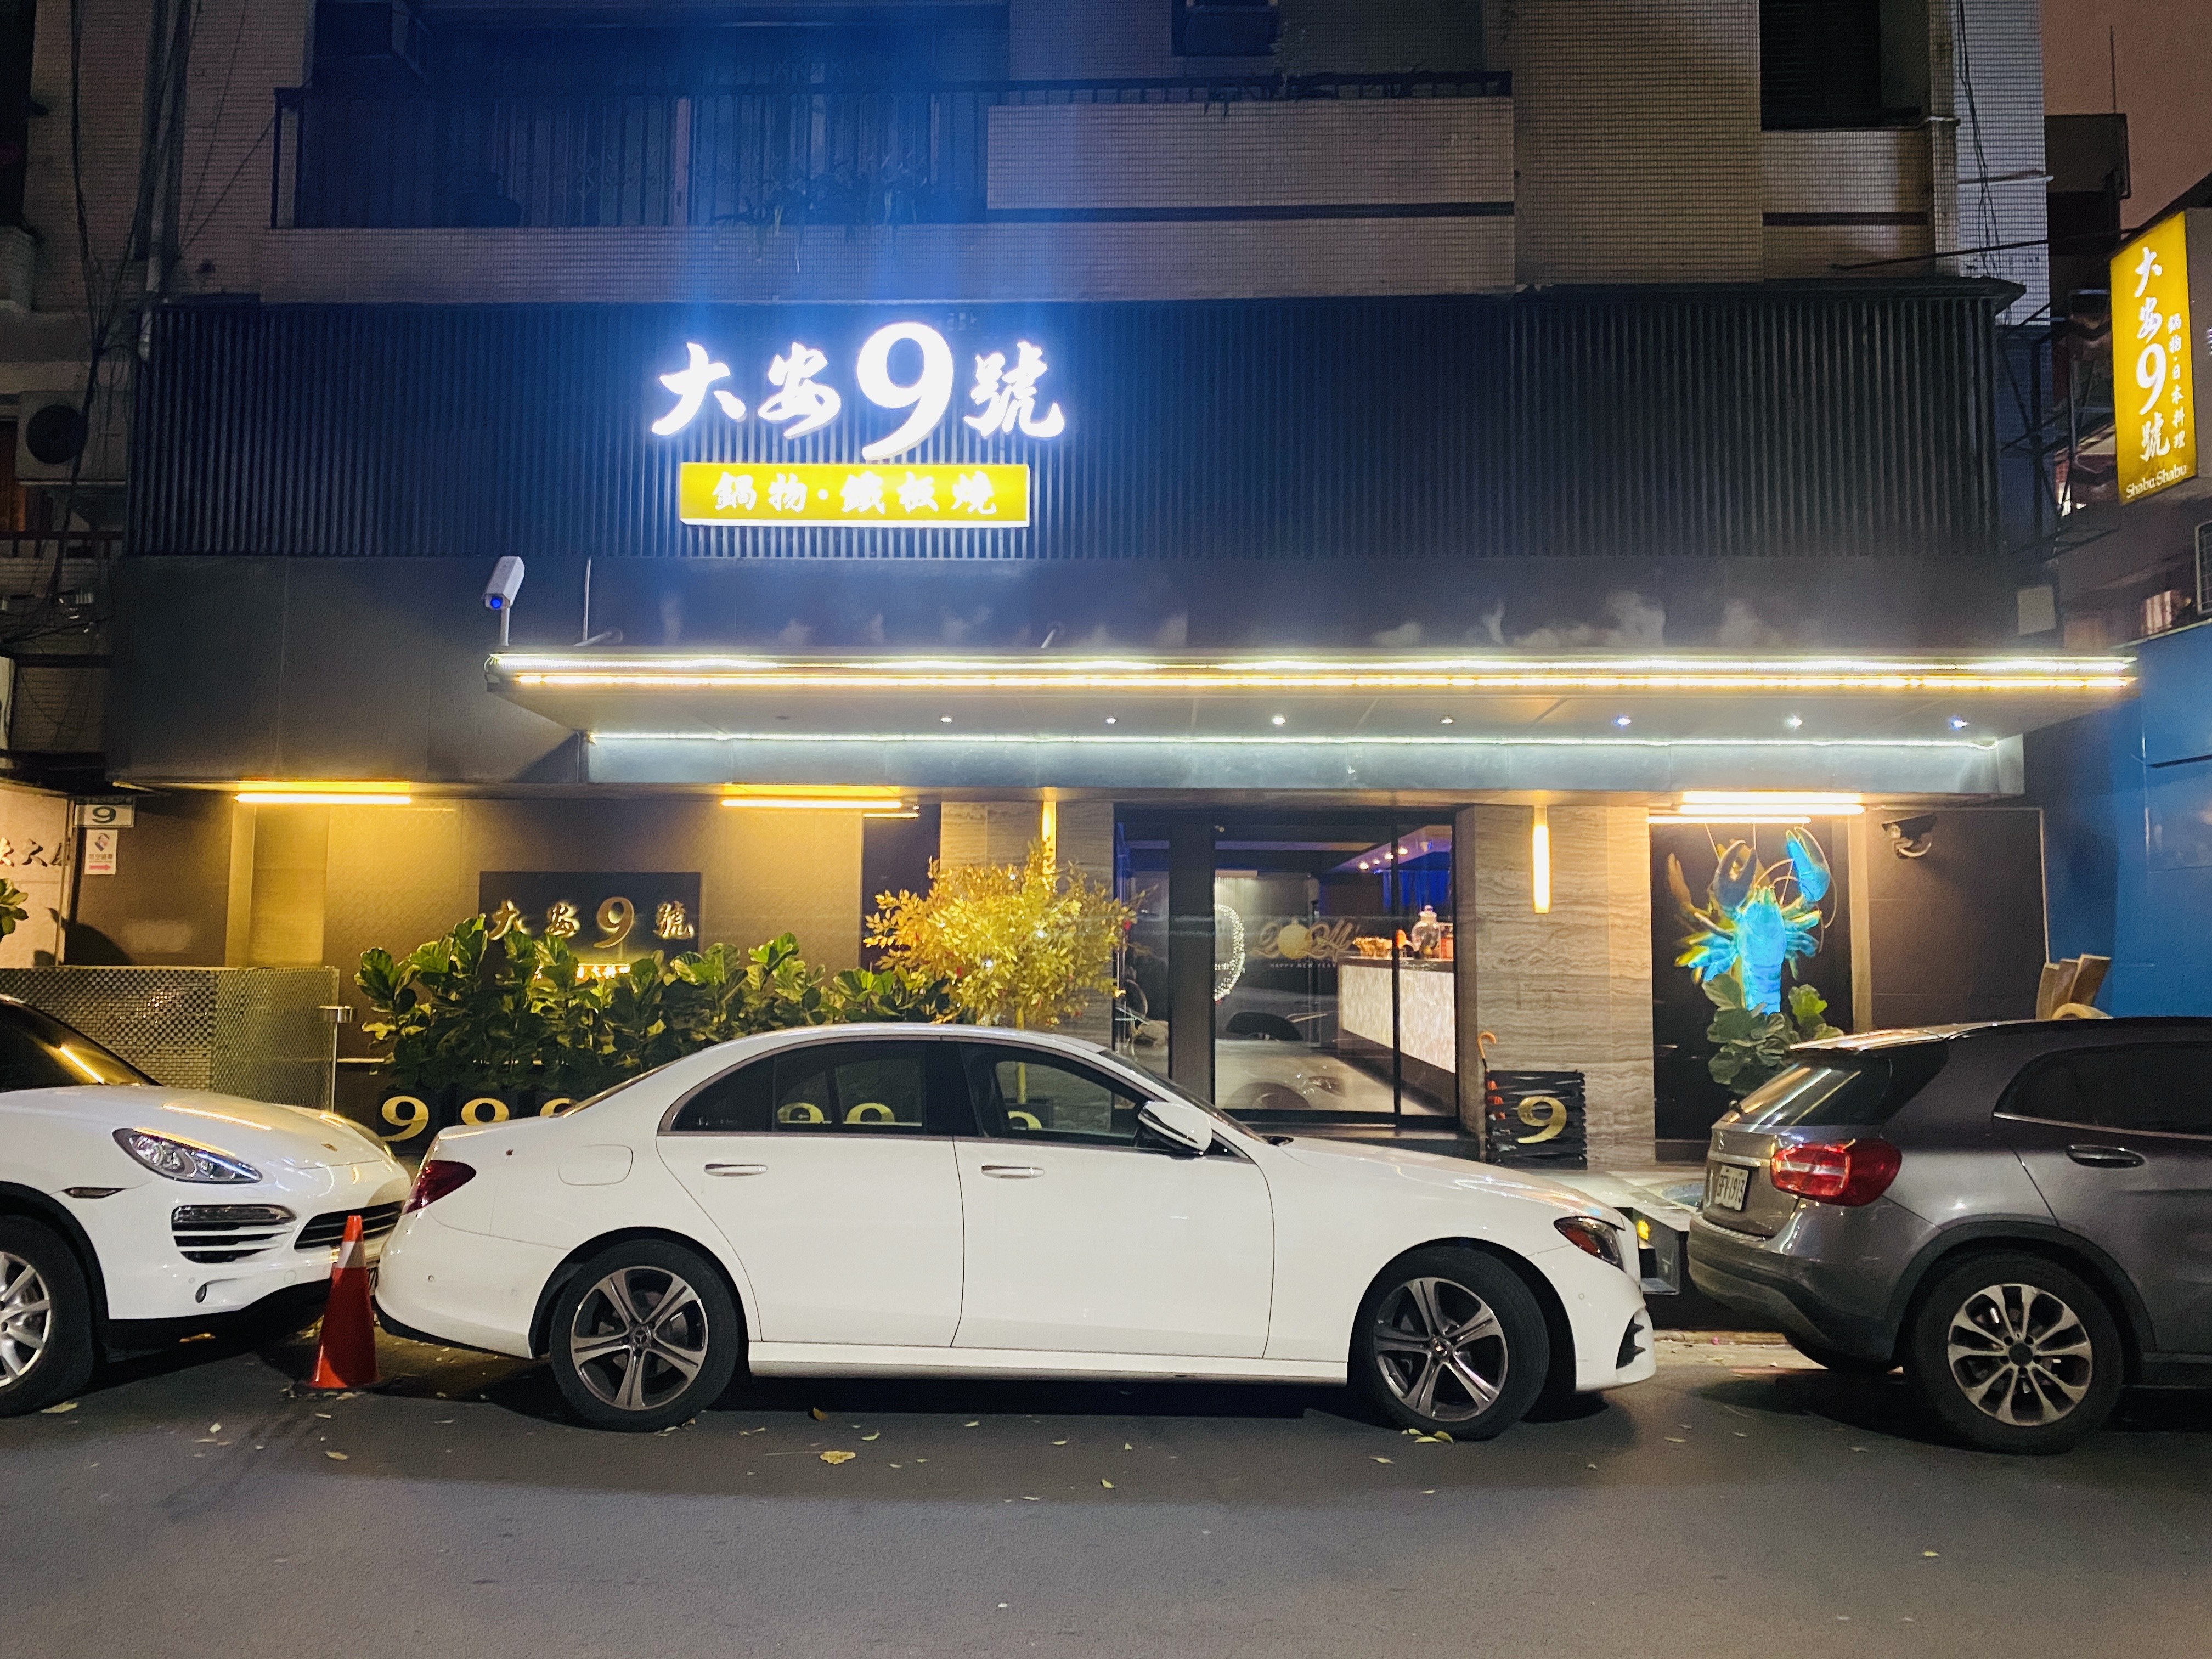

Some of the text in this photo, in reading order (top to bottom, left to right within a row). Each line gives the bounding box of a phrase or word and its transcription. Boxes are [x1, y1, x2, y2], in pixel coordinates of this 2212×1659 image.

[2134, 246, 2170, 462] 大安9號
[651, 322, 1065, 461] 大安9號
[2126, 464, 2187, 499] Shabu Shabu
[92, 806, 117, 823] 9
[487, 896, 695, 949] 大安9號
[381, 1096, 429, 1142] 9
[1517, 1096, 1567, 1144] 9
